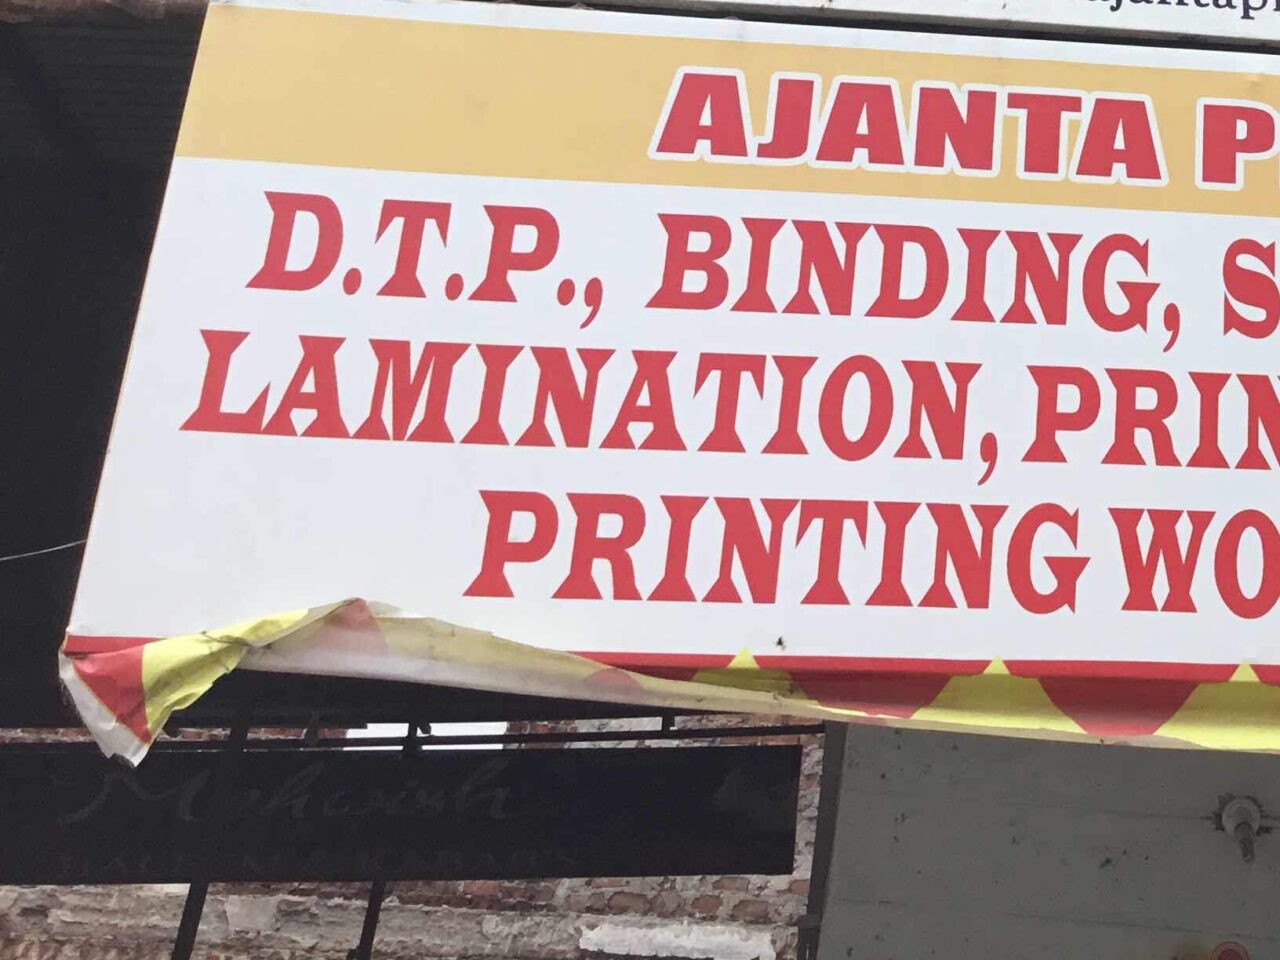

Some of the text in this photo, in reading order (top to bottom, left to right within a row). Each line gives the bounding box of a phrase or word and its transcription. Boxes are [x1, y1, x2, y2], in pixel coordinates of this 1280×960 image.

[662, 71, 1162, 181] AJANTA
[247, 191, 603, 328] D.T.P.,
[644, 212, 1182, 353] BINDING,
[180, 329, 998, 484] LAMINATION,
[463, 489, 1089, 615] PRINTING
